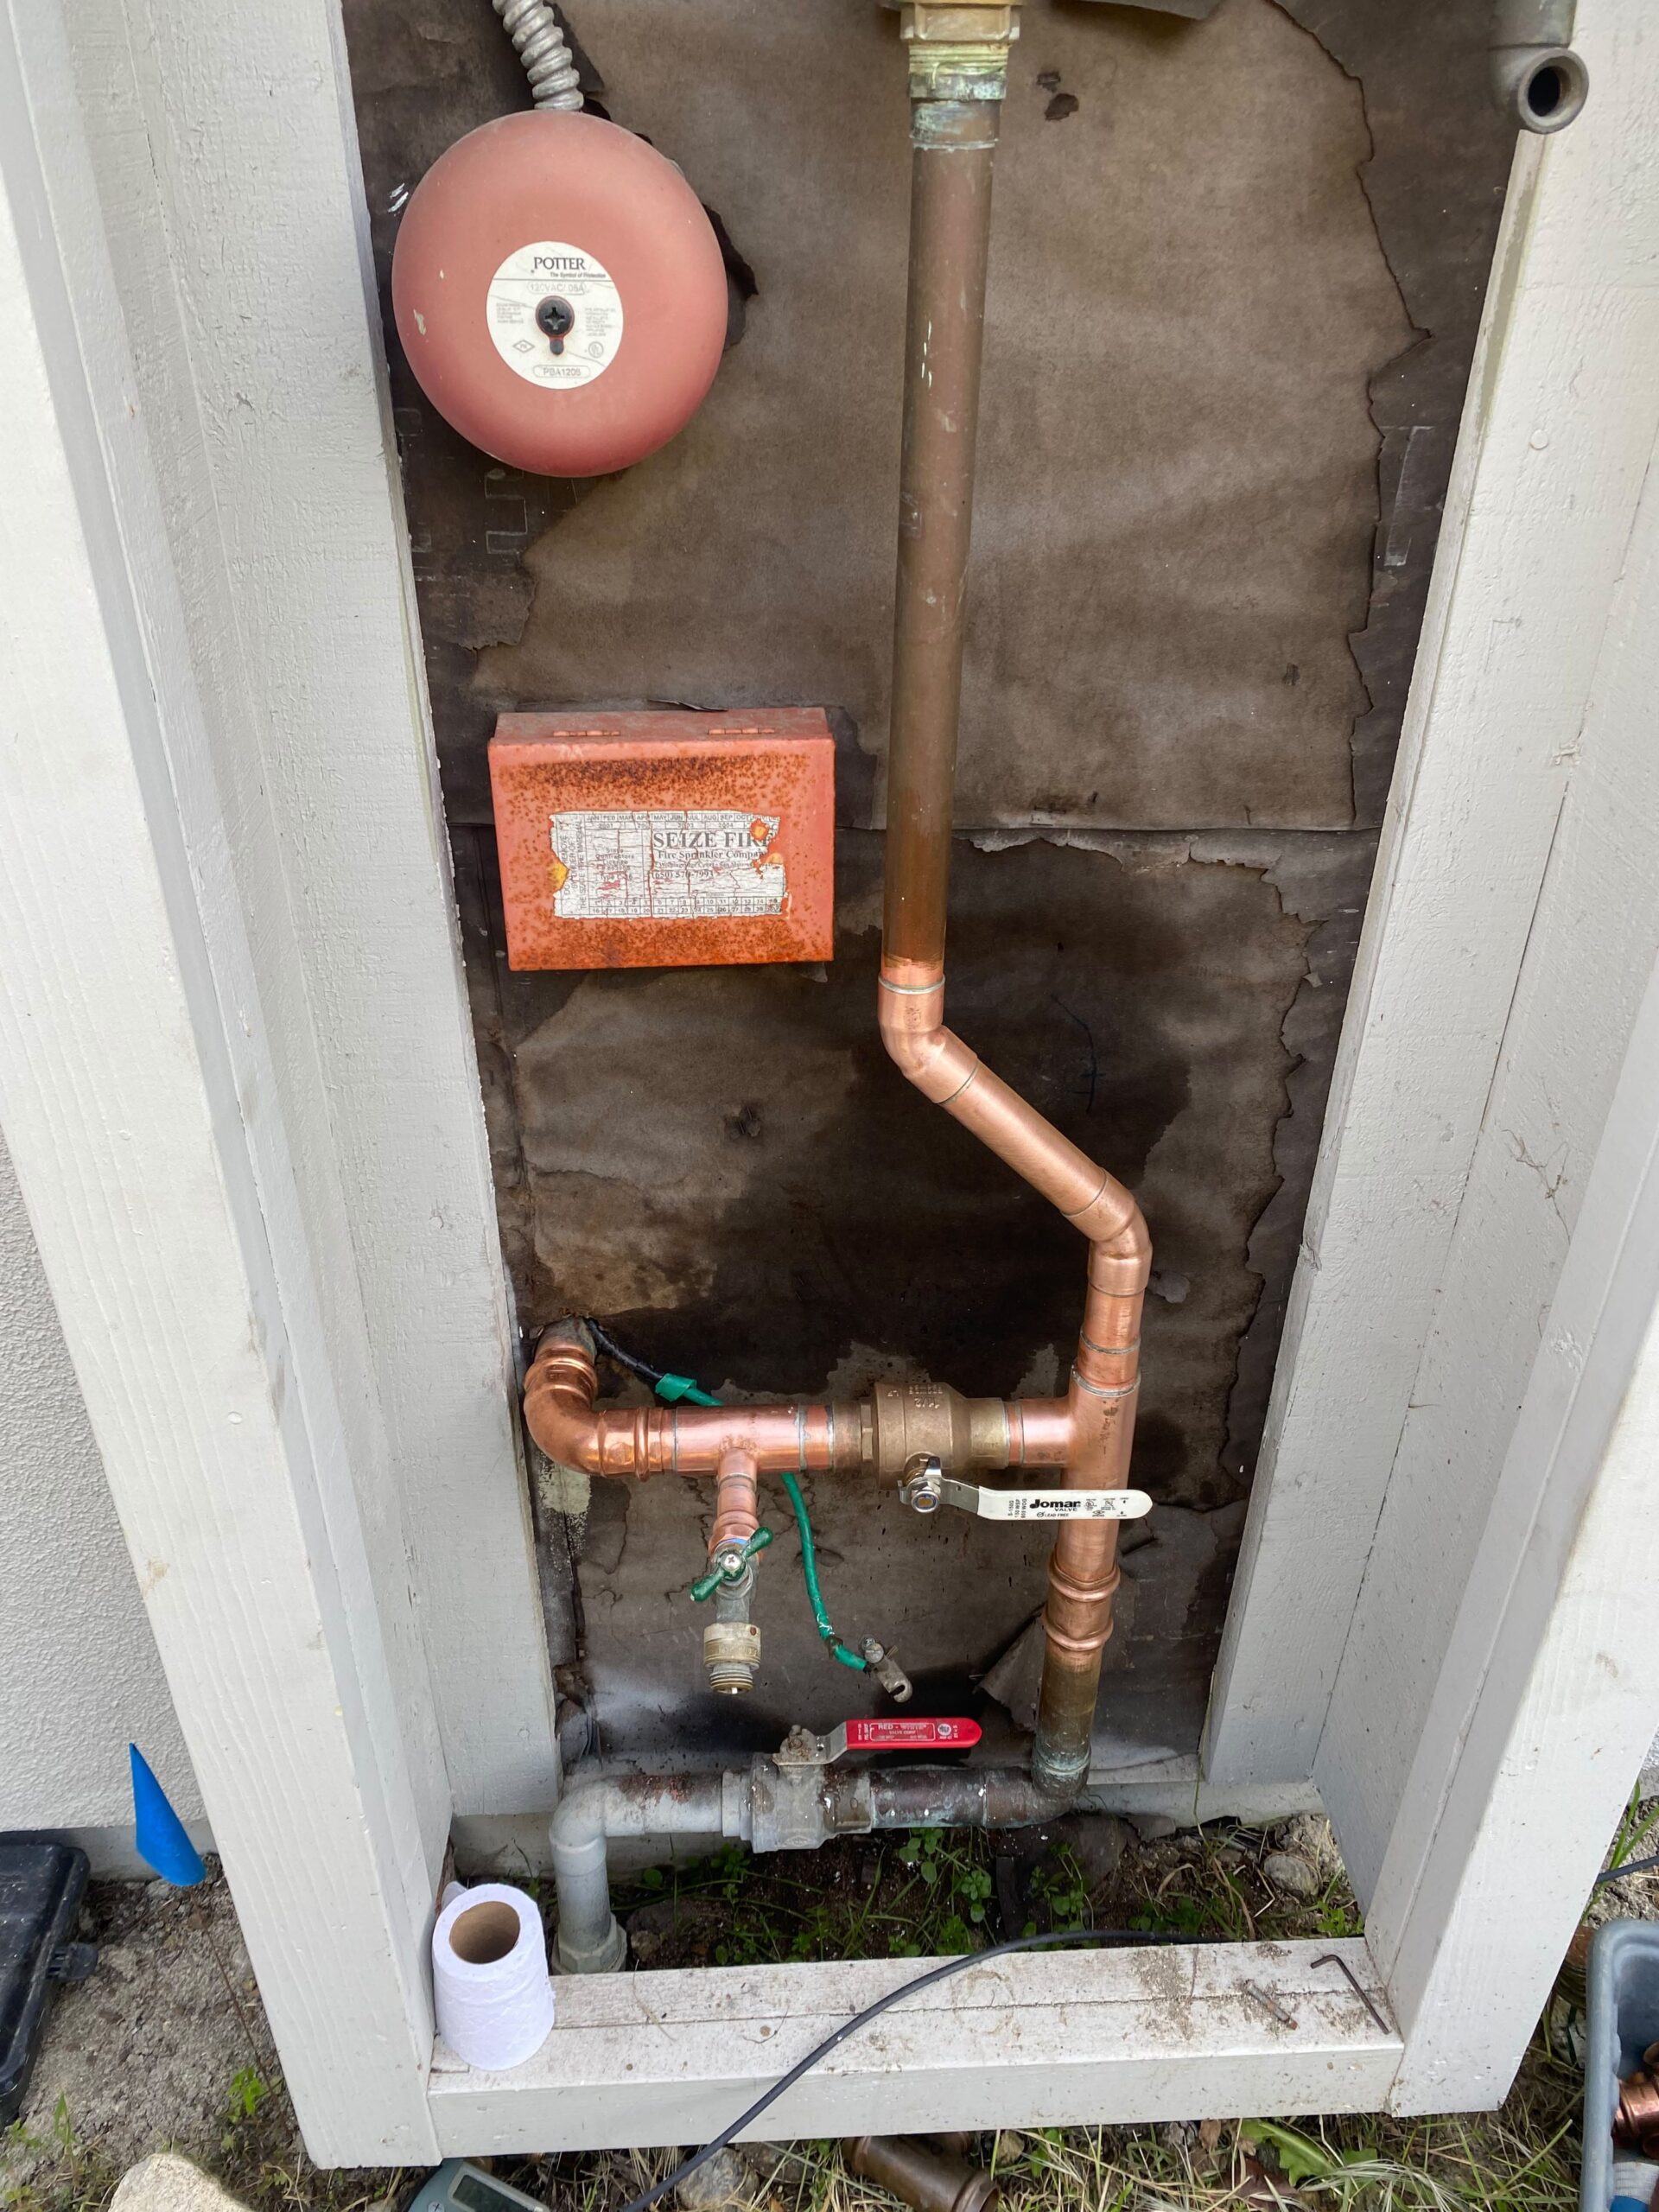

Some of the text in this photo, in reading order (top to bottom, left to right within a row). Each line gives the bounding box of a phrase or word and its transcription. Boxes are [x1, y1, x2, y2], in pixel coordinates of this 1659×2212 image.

[533, 257, 586, 270] POTTER
[653, 832, 717, 849] SEIZE
[658, 850, 677, 859] Fire
[679, 849, 723, 860] Sprinkler
[652, 870, 673, 880] (650)
[1029, 1498, 1082, 1509] Jomar
